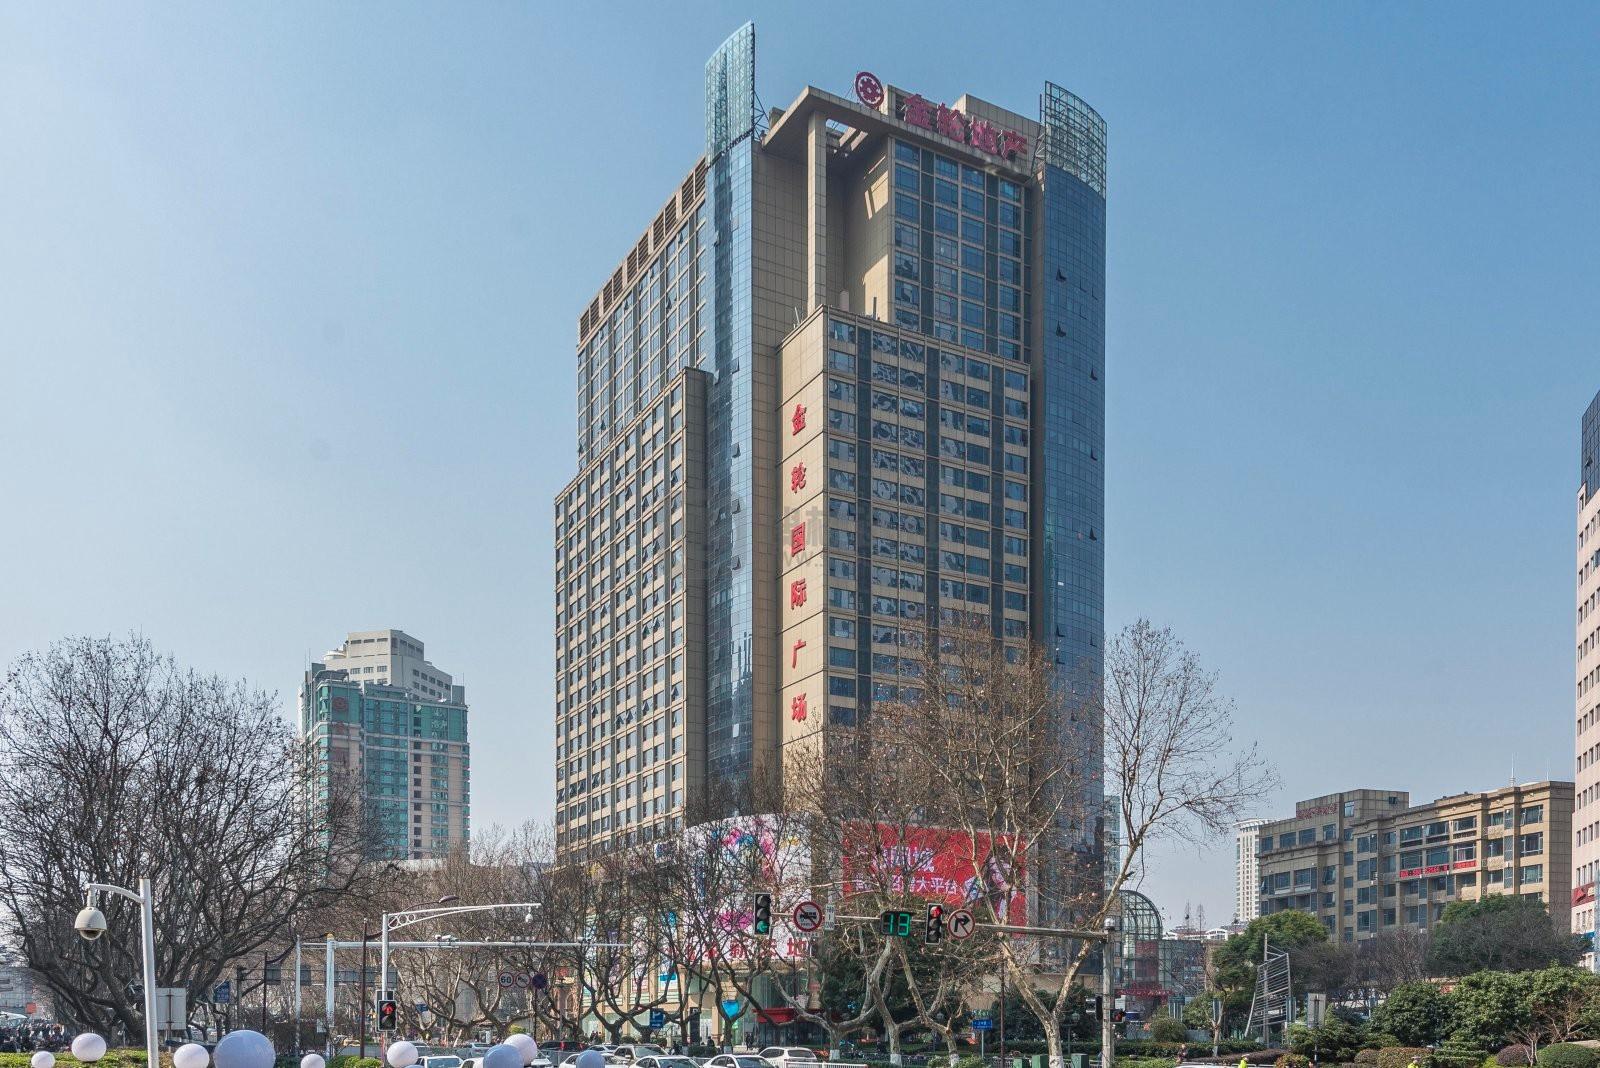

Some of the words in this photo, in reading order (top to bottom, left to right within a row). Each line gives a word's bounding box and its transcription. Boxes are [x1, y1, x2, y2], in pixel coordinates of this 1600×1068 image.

[903, 94, 1027, 160] 金轮地产
[790, 403, 808, 722] 金轮国际广场
[890, 913, 910, 936] 13
[501, 976, 512, 984] 60
